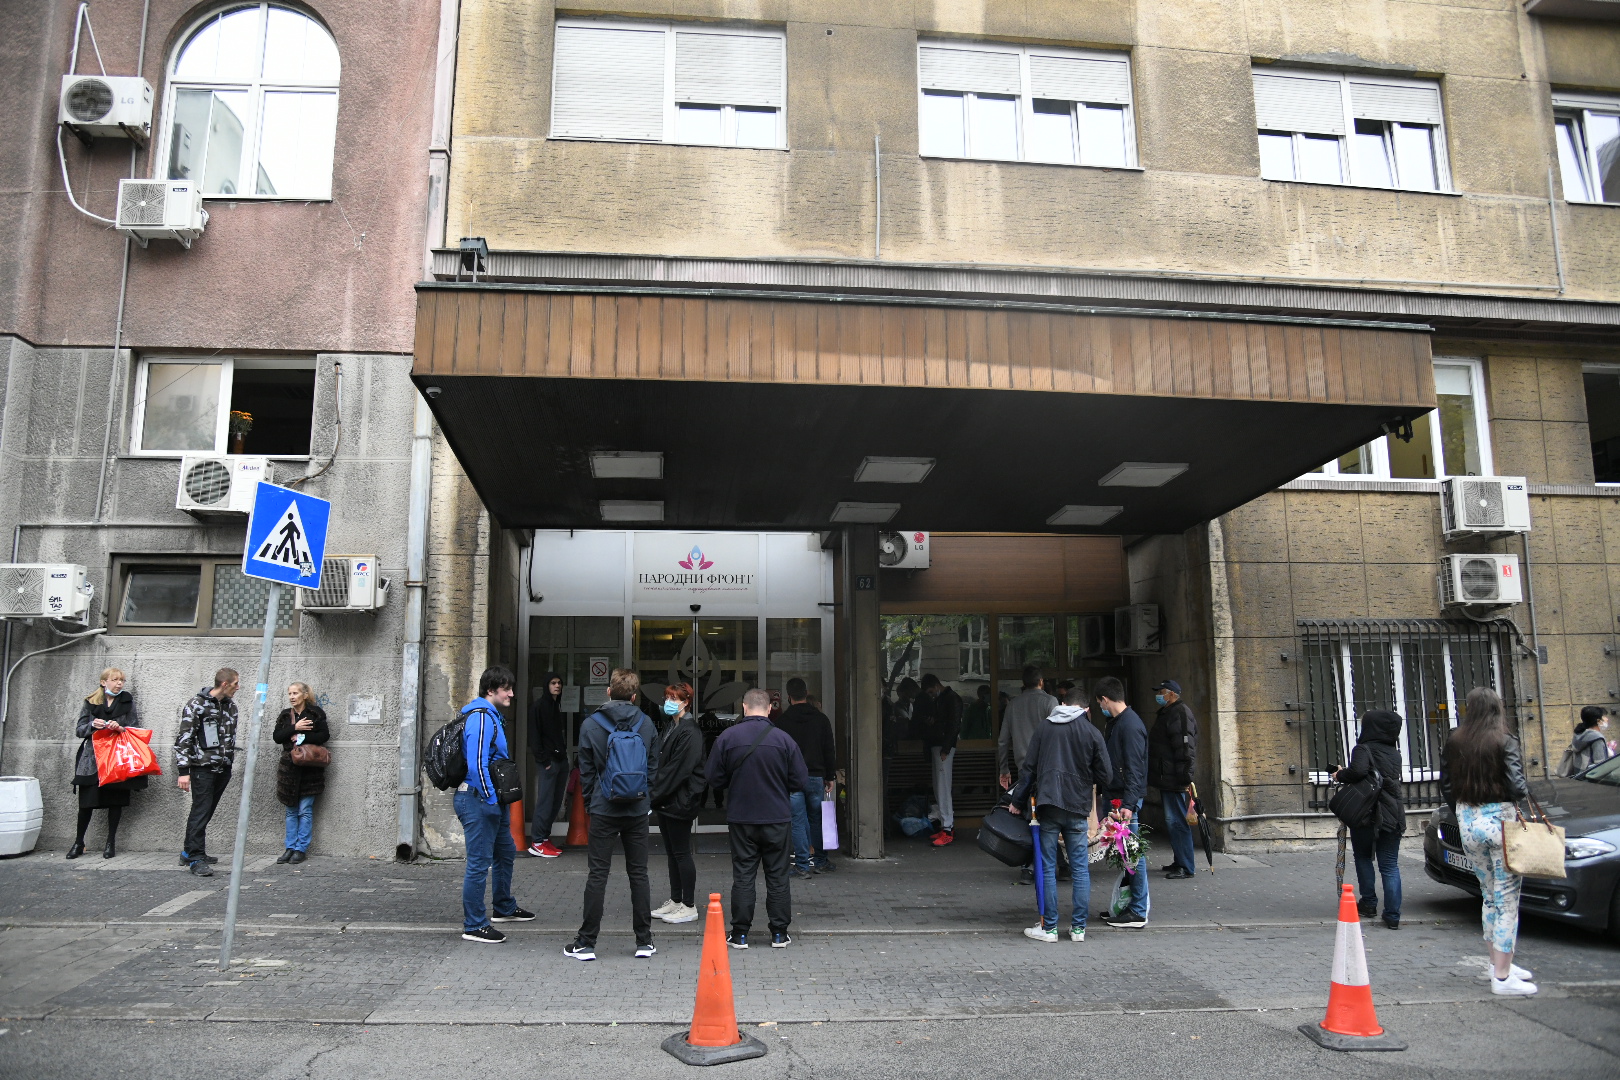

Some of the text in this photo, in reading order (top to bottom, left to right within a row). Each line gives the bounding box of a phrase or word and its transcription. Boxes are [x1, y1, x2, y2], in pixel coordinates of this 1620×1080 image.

[638, 573, 754, 586] НАРОДНИ ФРОНТ
[858, 577, 871, 588] 62
